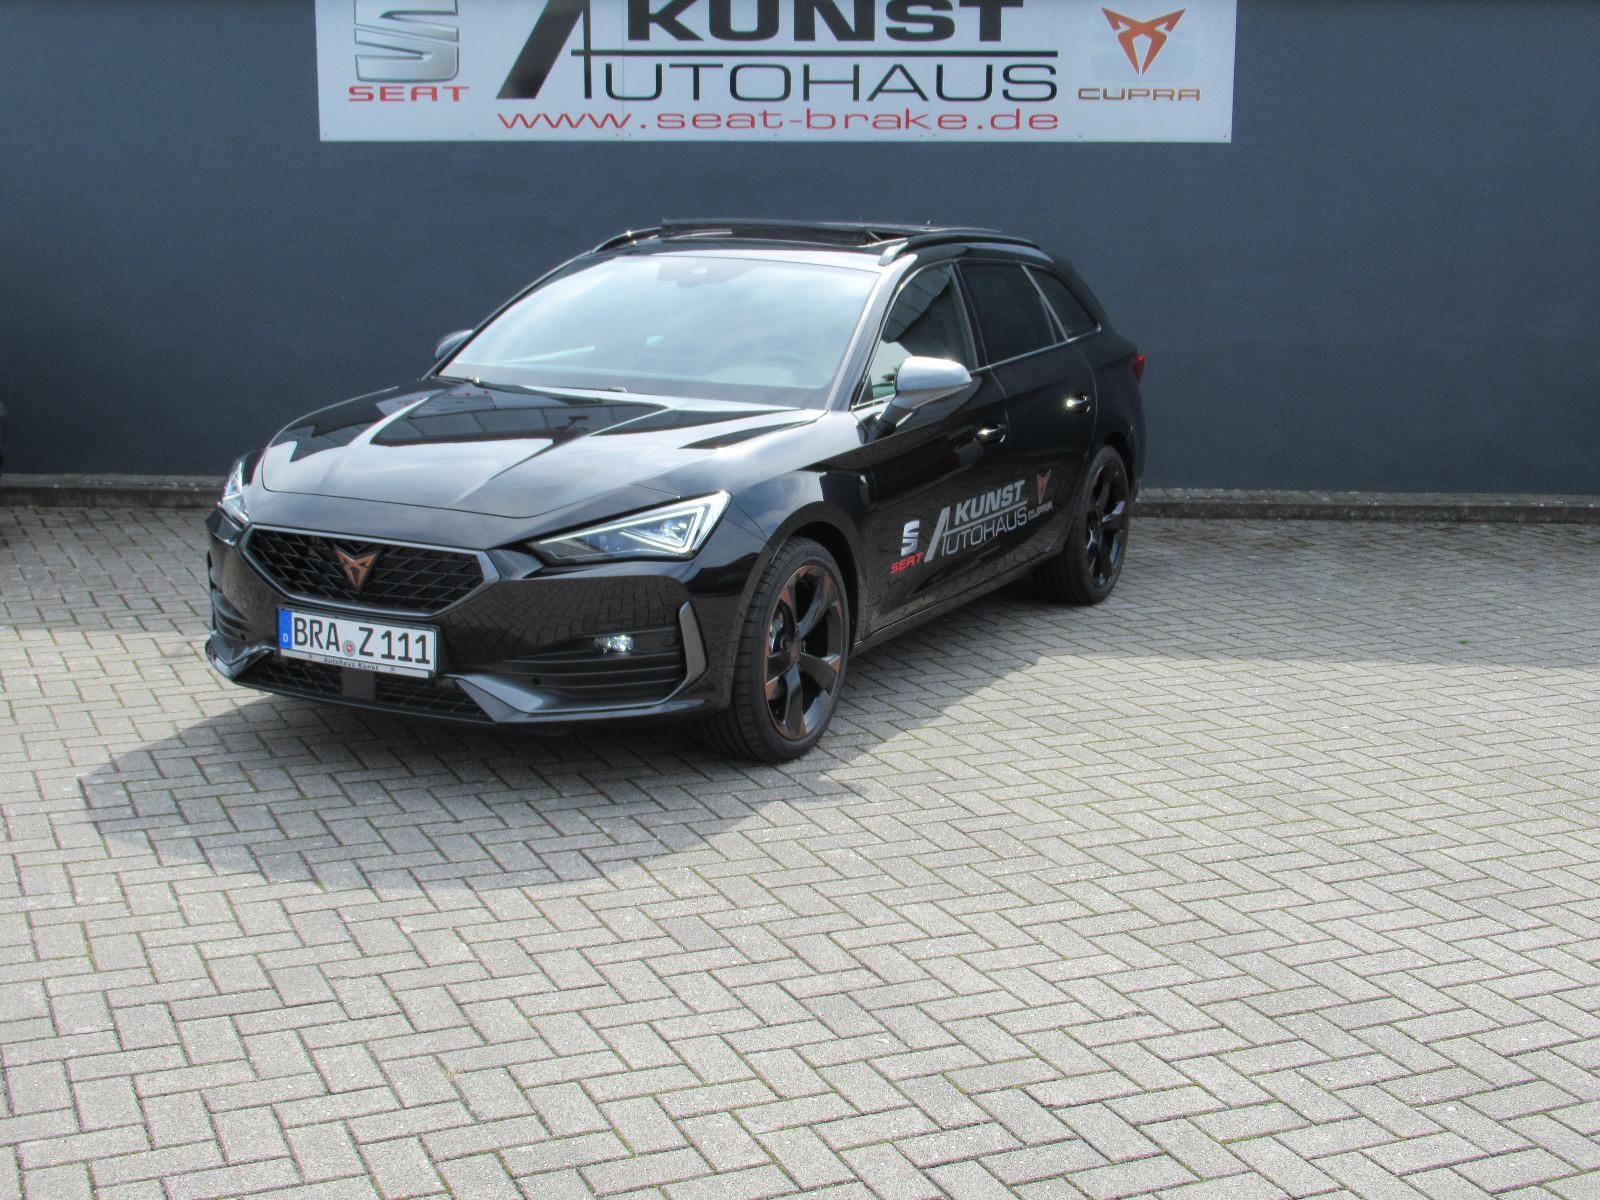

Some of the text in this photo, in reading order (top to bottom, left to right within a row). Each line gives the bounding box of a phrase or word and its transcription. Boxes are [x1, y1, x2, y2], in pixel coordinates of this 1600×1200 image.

[627, 0, 1024, 42] KUNST
[348, 86, 470, 102] SEAT
[1077, 88, 1200, 102] CUPRA
[497, 108, 1059, 130] www.seat-brake.de
[954, 479, 1026, 526] KUNST
[889, 551, 924, 574] SEAT
[294, 616, 341, 652] BRA
